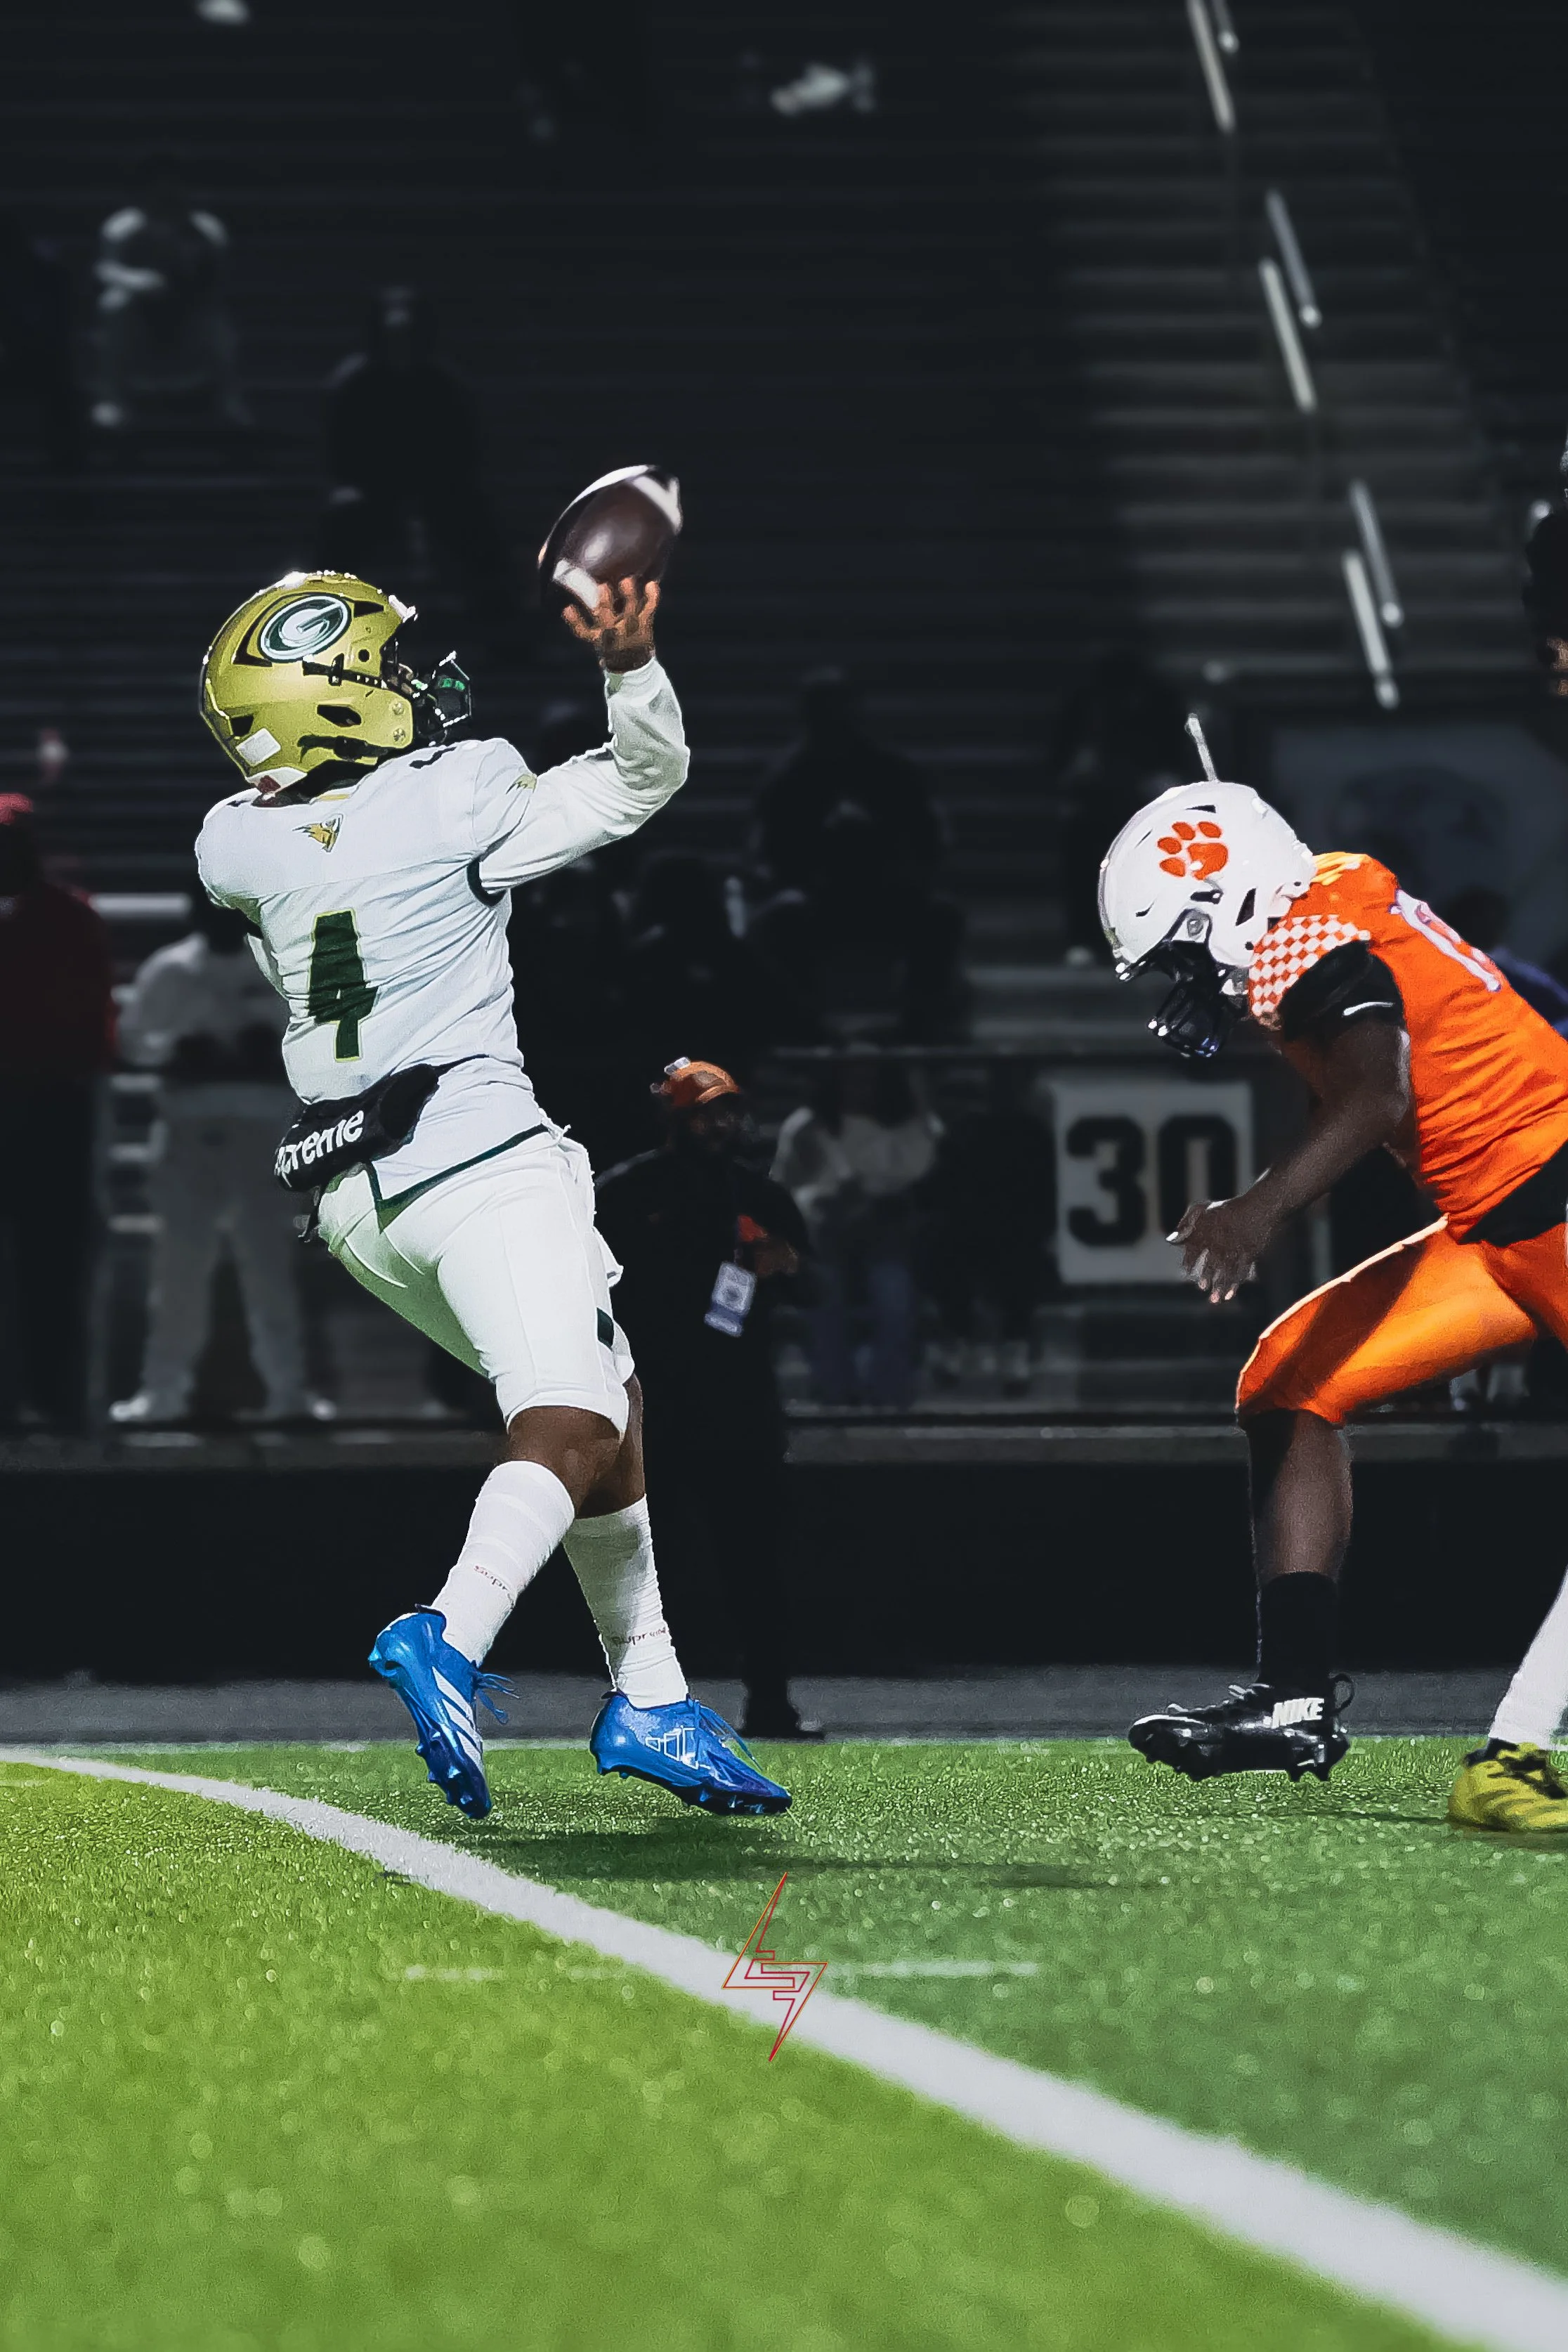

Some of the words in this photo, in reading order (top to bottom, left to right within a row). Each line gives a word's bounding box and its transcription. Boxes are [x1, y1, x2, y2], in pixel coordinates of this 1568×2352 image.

[260, 595, 348, 661] G
[308, 909, 380, 1063] 4
[1065, 1112, 1238, 1248] 30
[1270, 1697, 1325, 1729] NIKE
